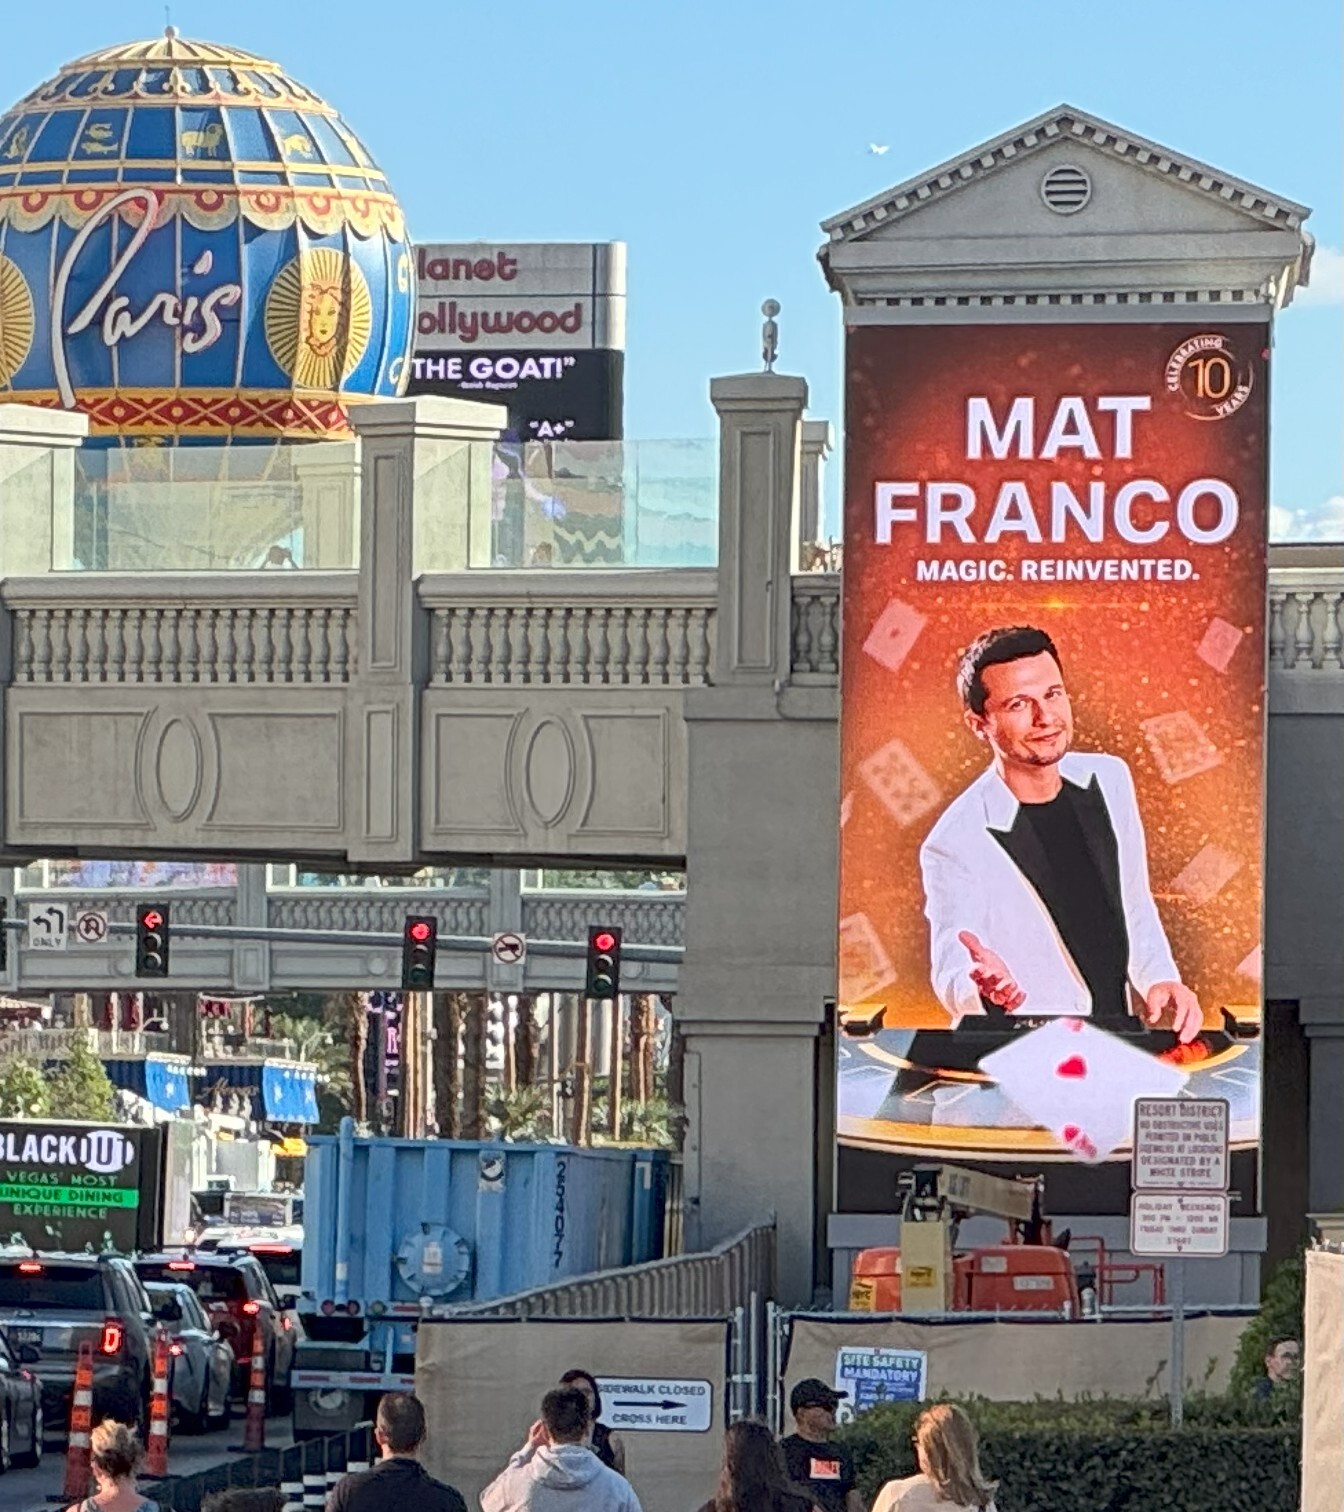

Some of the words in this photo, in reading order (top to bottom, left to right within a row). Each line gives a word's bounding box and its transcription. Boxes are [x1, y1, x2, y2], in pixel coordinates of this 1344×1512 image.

[417, 248, 518, 281] lanet
[52, 188, 242, 409] Paris
[417, 301, 583, 343] ollywood
[1167, 337, 1223, 392] CELEBRATING
[1188, 357, 1231, 399] 10
[1215, 385, 1250, 415] YEARS
[967, 396, 1152, 460] MAT
[874, 478, 1239, 545] FRANCO
[916, 559, 1014, 581] MAGIC.
[1021, 559, 1200, 581] REINVENTED.
[32, 937, 62, 947] ONLY
[1139, 1104, 1177, 1117] RESORT
[1179, 1104, 1223, 1118] DISTRICT
[1145, 1132, 1180, 1142] PERMITTED
[1141, 1156, 1196, 1166] DESIGNATED
[1199, 1156, 1211, 1166] BY
[71, 1174, 118, 1187] MOST
[1150, 1167, 1176, 1177] WHITE
[1179, 1168, 1212, 1178] STRIPE
[0, 1187, 62, 1201] UNIQUE
[68, 1190, 124, 1204] DINING
[13, 1203, 109, 1220] EXPERIENCE
[843, 1354, 871, 1366] SITE
[873, 1356, 920, 1370] SAFETY
[843, 1366, 919, 1382] MANDATORY
[658, 1385, 706, 1396] CLOSED
[612, 1413, 652, 1424] CROSS
[655, 1414, 688, 1425] HERE
